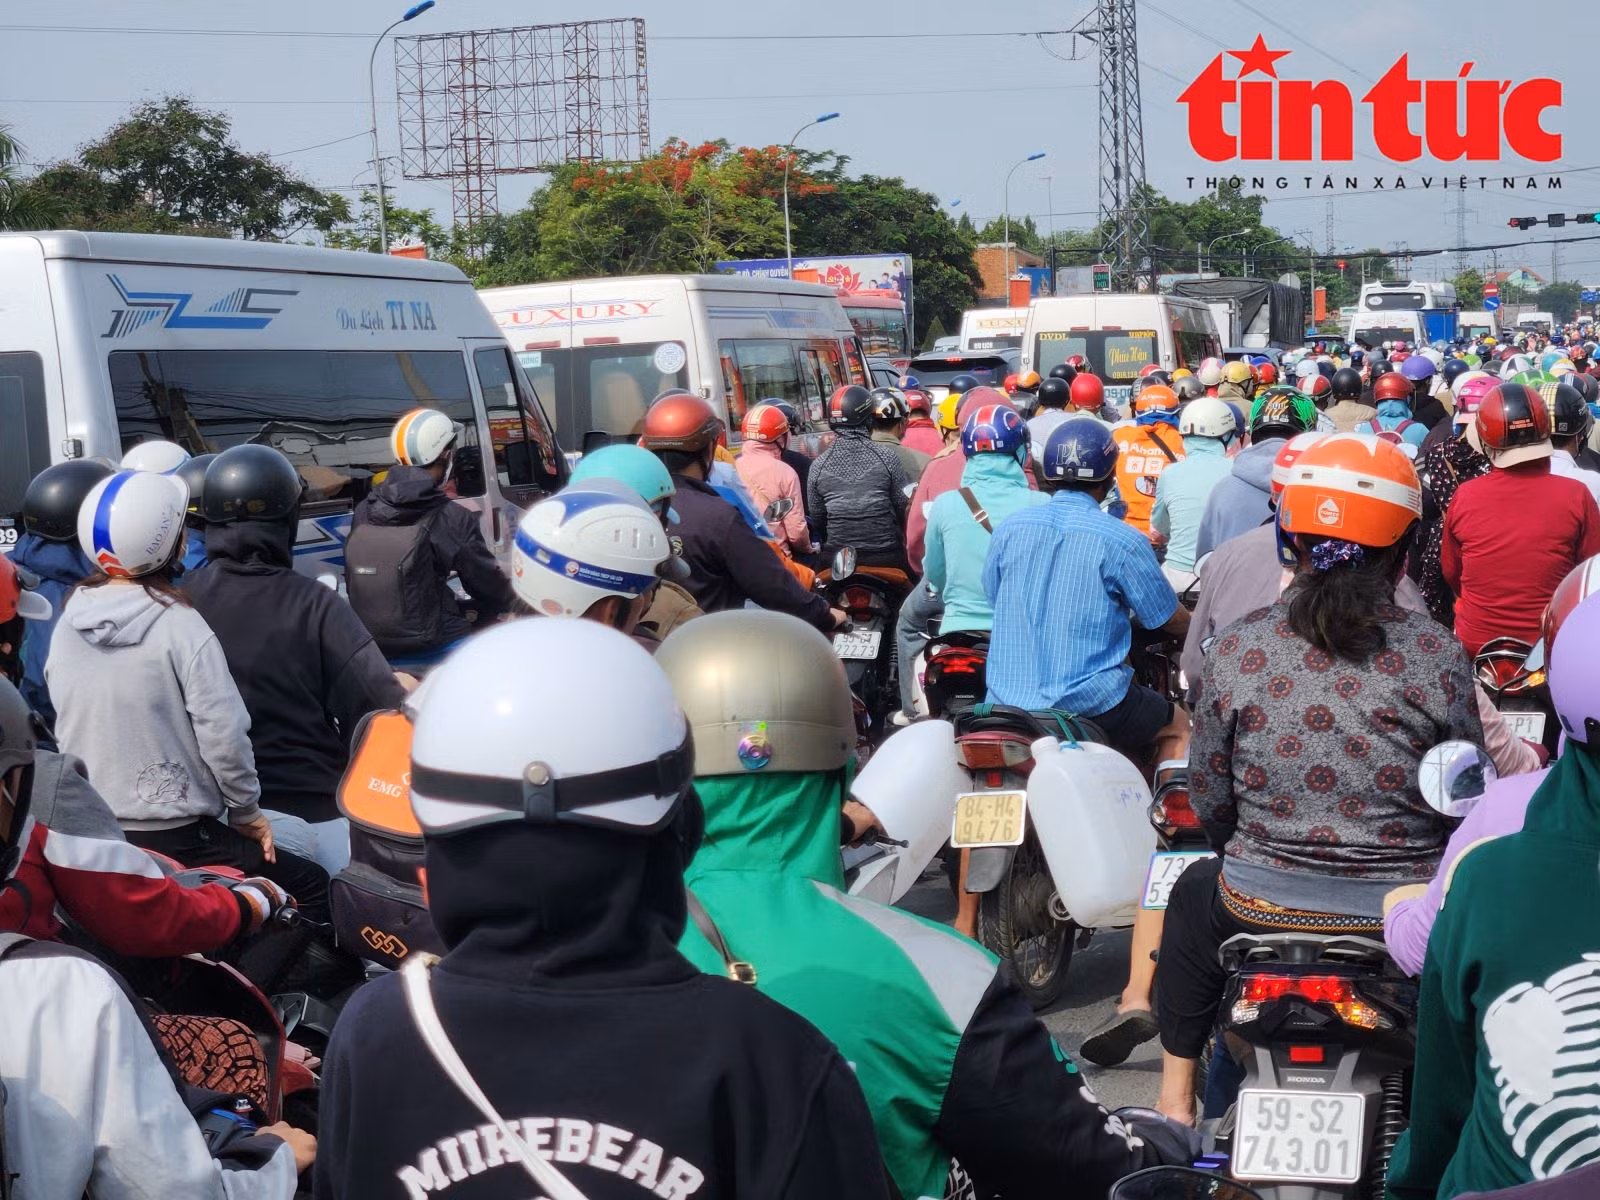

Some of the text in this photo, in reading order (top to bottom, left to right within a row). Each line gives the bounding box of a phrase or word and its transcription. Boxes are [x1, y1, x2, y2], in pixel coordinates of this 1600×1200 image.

[335, 308, 357, 330] Du
[499, 301, 656, 326] UXURY
[1039, 332, 1069, 341] DVDL
[964, 795, 1014, 818] 84-H4
[963, 819, 1013, 842] 9476
[1286, 1076, 1326, 1084] HONDA
[1256, 1096, 1344, 1135] 59-S2
[1242, 1135, 1350, 1176] 743.01
